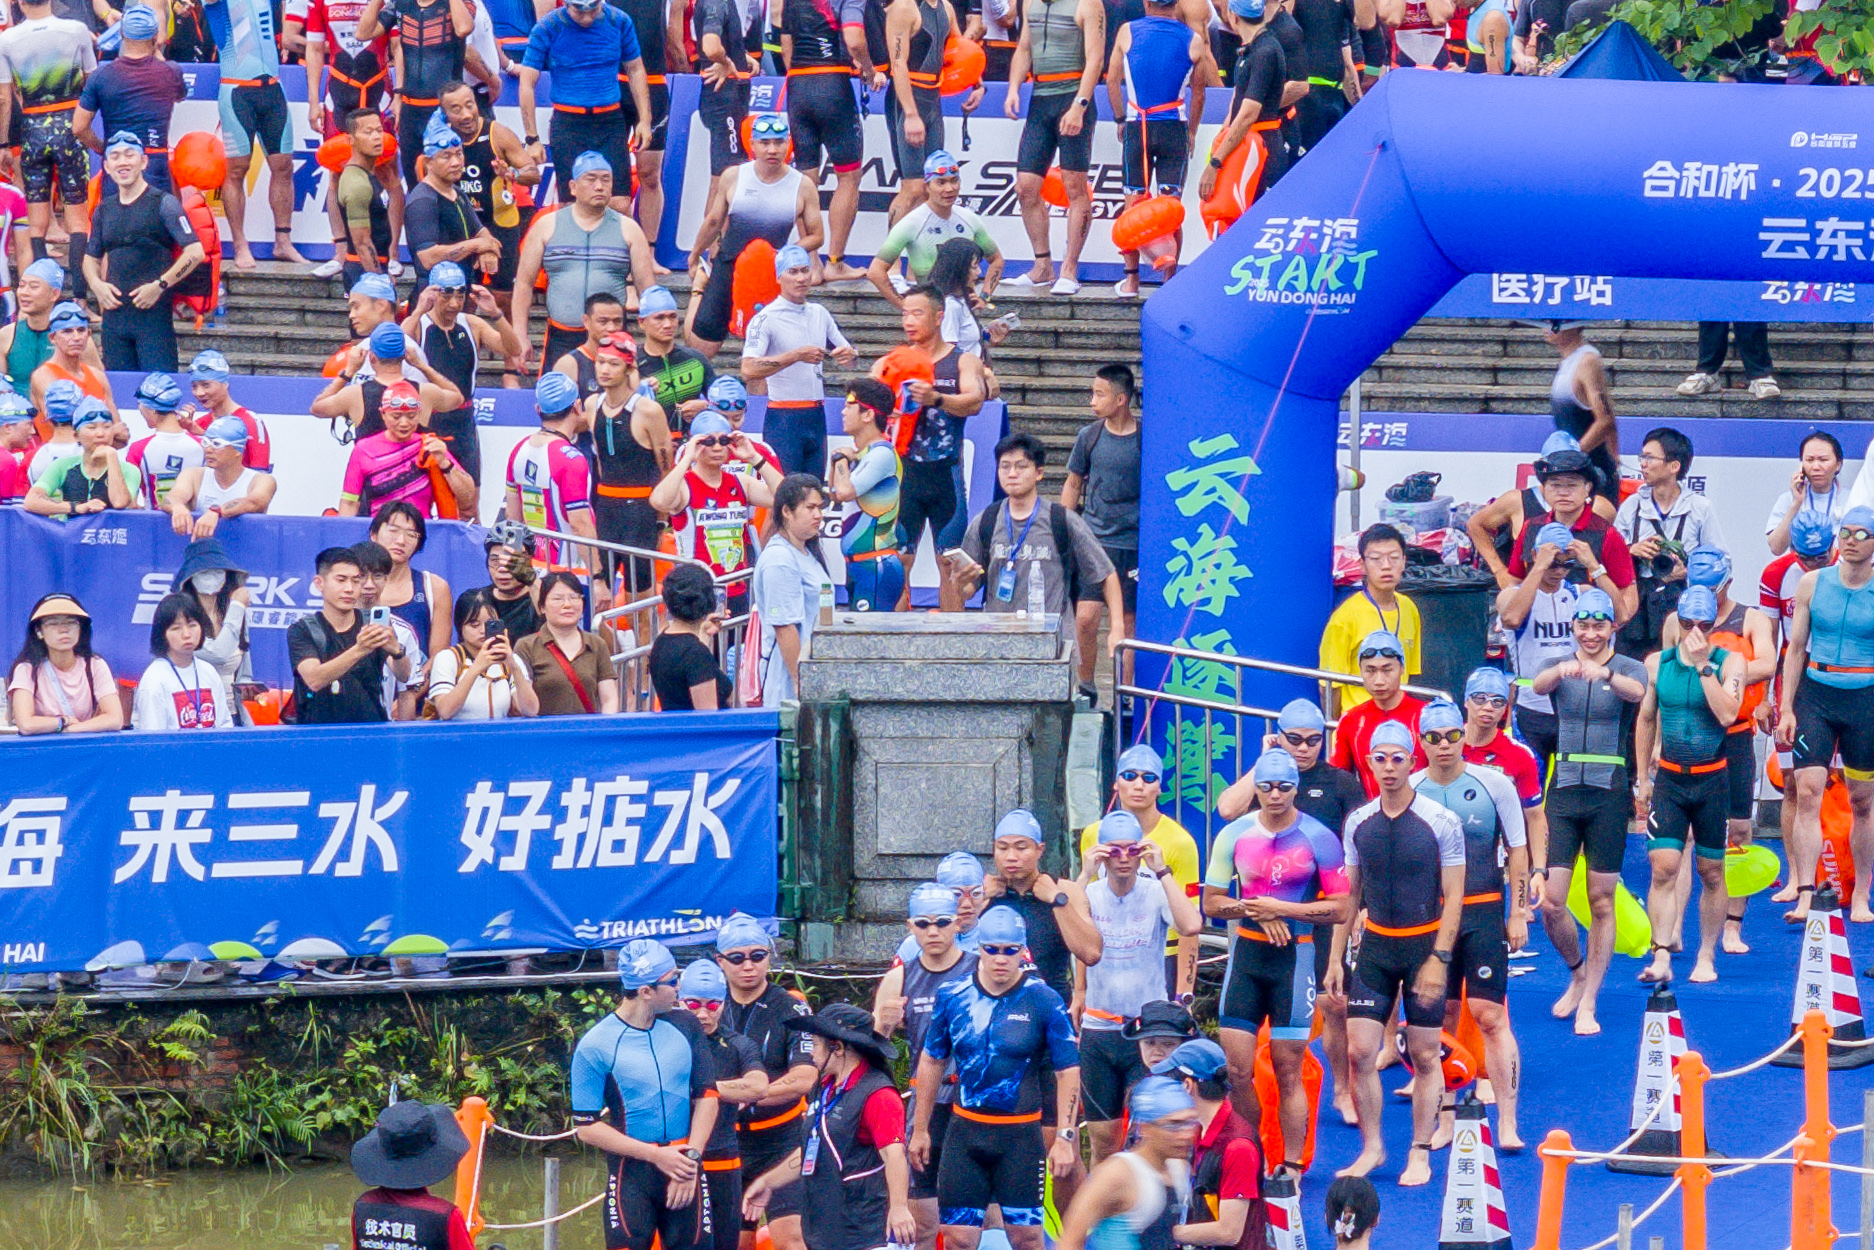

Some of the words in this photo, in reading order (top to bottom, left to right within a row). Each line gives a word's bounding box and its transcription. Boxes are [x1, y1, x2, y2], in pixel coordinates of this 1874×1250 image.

[1254, 217, 1359, 255] 云东海
[1223, 250, 1379, 296] START
[1492, 273, 1613, 306] 医疗站
[1247, 288, 1280, 303] YUN
[1280, 291, 1329, 305] DONG
[1330, 293, 1357, 305] HAI
[114, 784, 409, 884] 来三水
[3, 942, 45, 963] HAI
[1454, 1157, 1475, 1234] 第一赛道
[365, 1218, 416, 1241] 技术官员
